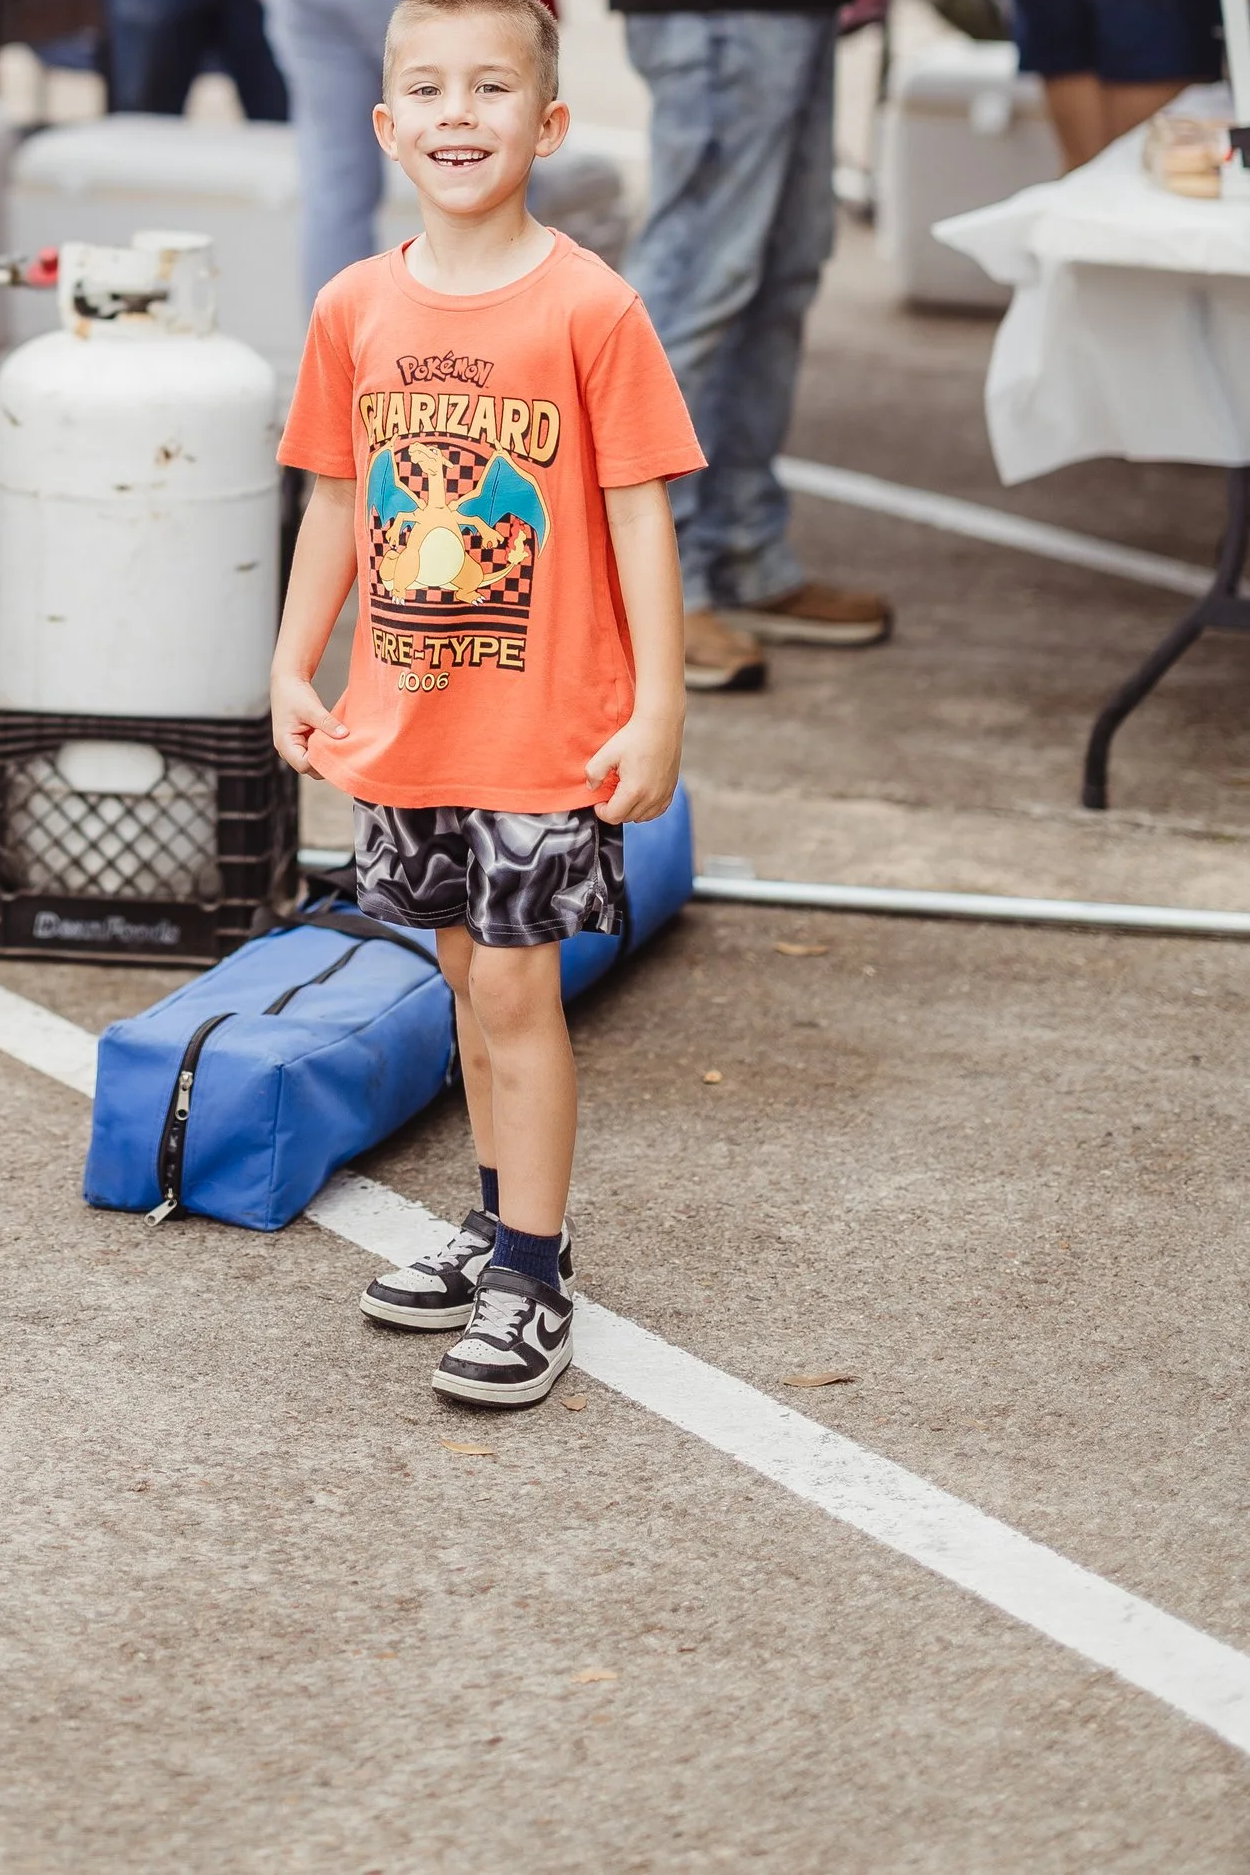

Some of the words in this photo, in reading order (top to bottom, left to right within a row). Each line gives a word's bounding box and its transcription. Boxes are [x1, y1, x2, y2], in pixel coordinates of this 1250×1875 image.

[359, 392, 561, 468] CHARIZARD
[372, 627, 526, 672] FIRE-TYPE
[398, 672, 450, 692] 0006
